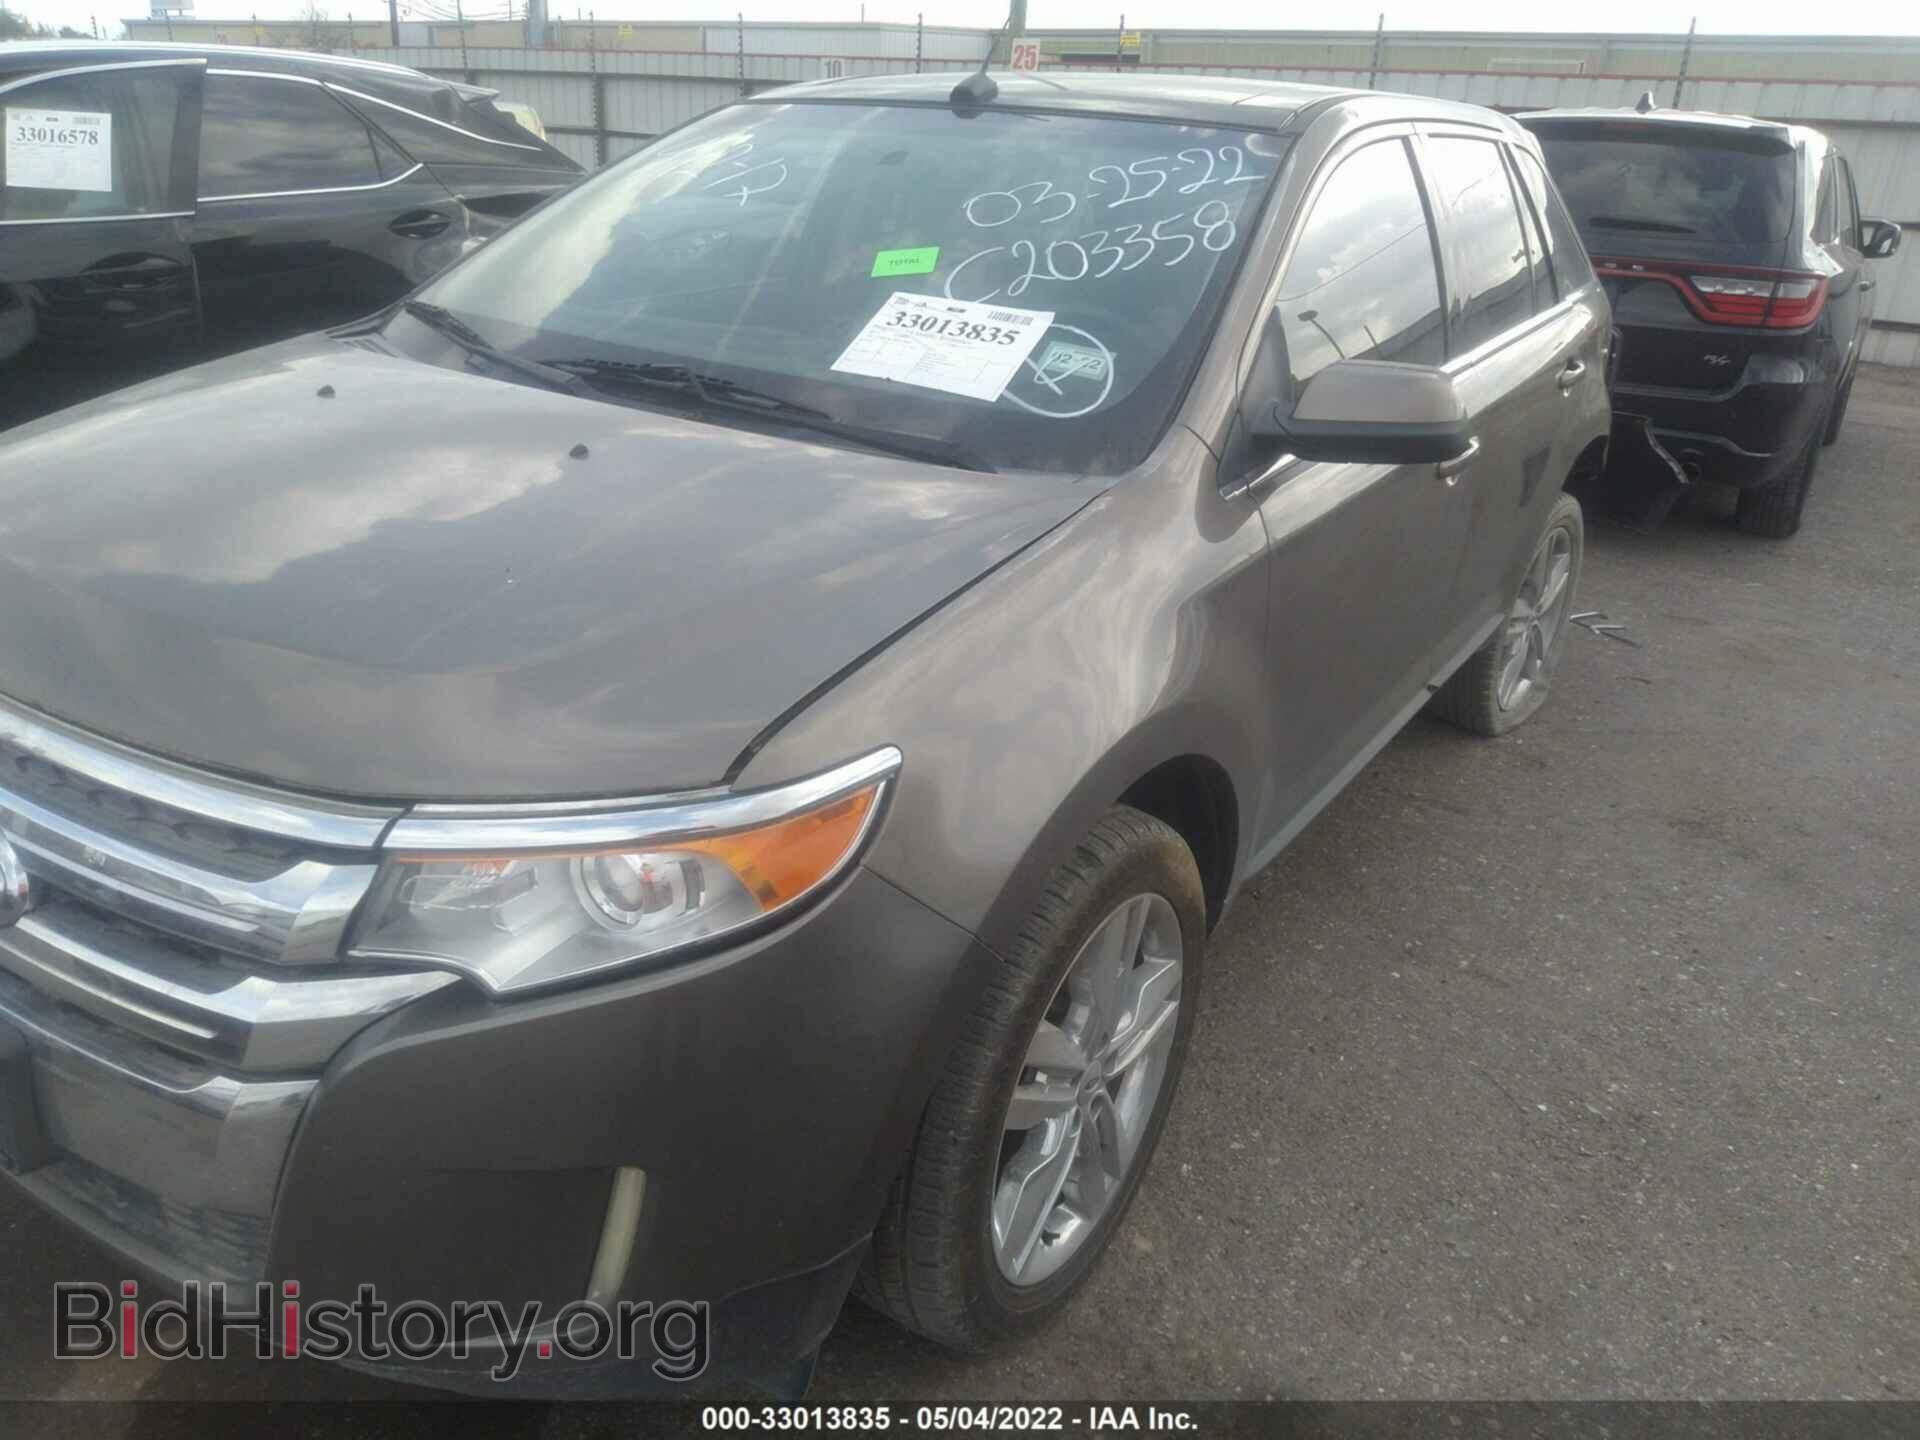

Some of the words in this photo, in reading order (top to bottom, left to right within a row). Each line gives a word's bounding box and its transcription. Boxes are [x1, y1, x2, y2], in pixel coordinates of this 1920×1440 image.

[1012, 44, 1038, 70] 25
[16, 126, 99, 146] 33016578
[944, 200, 1236, 303] C203358
[885, 311, 1021, 346] 33013835
